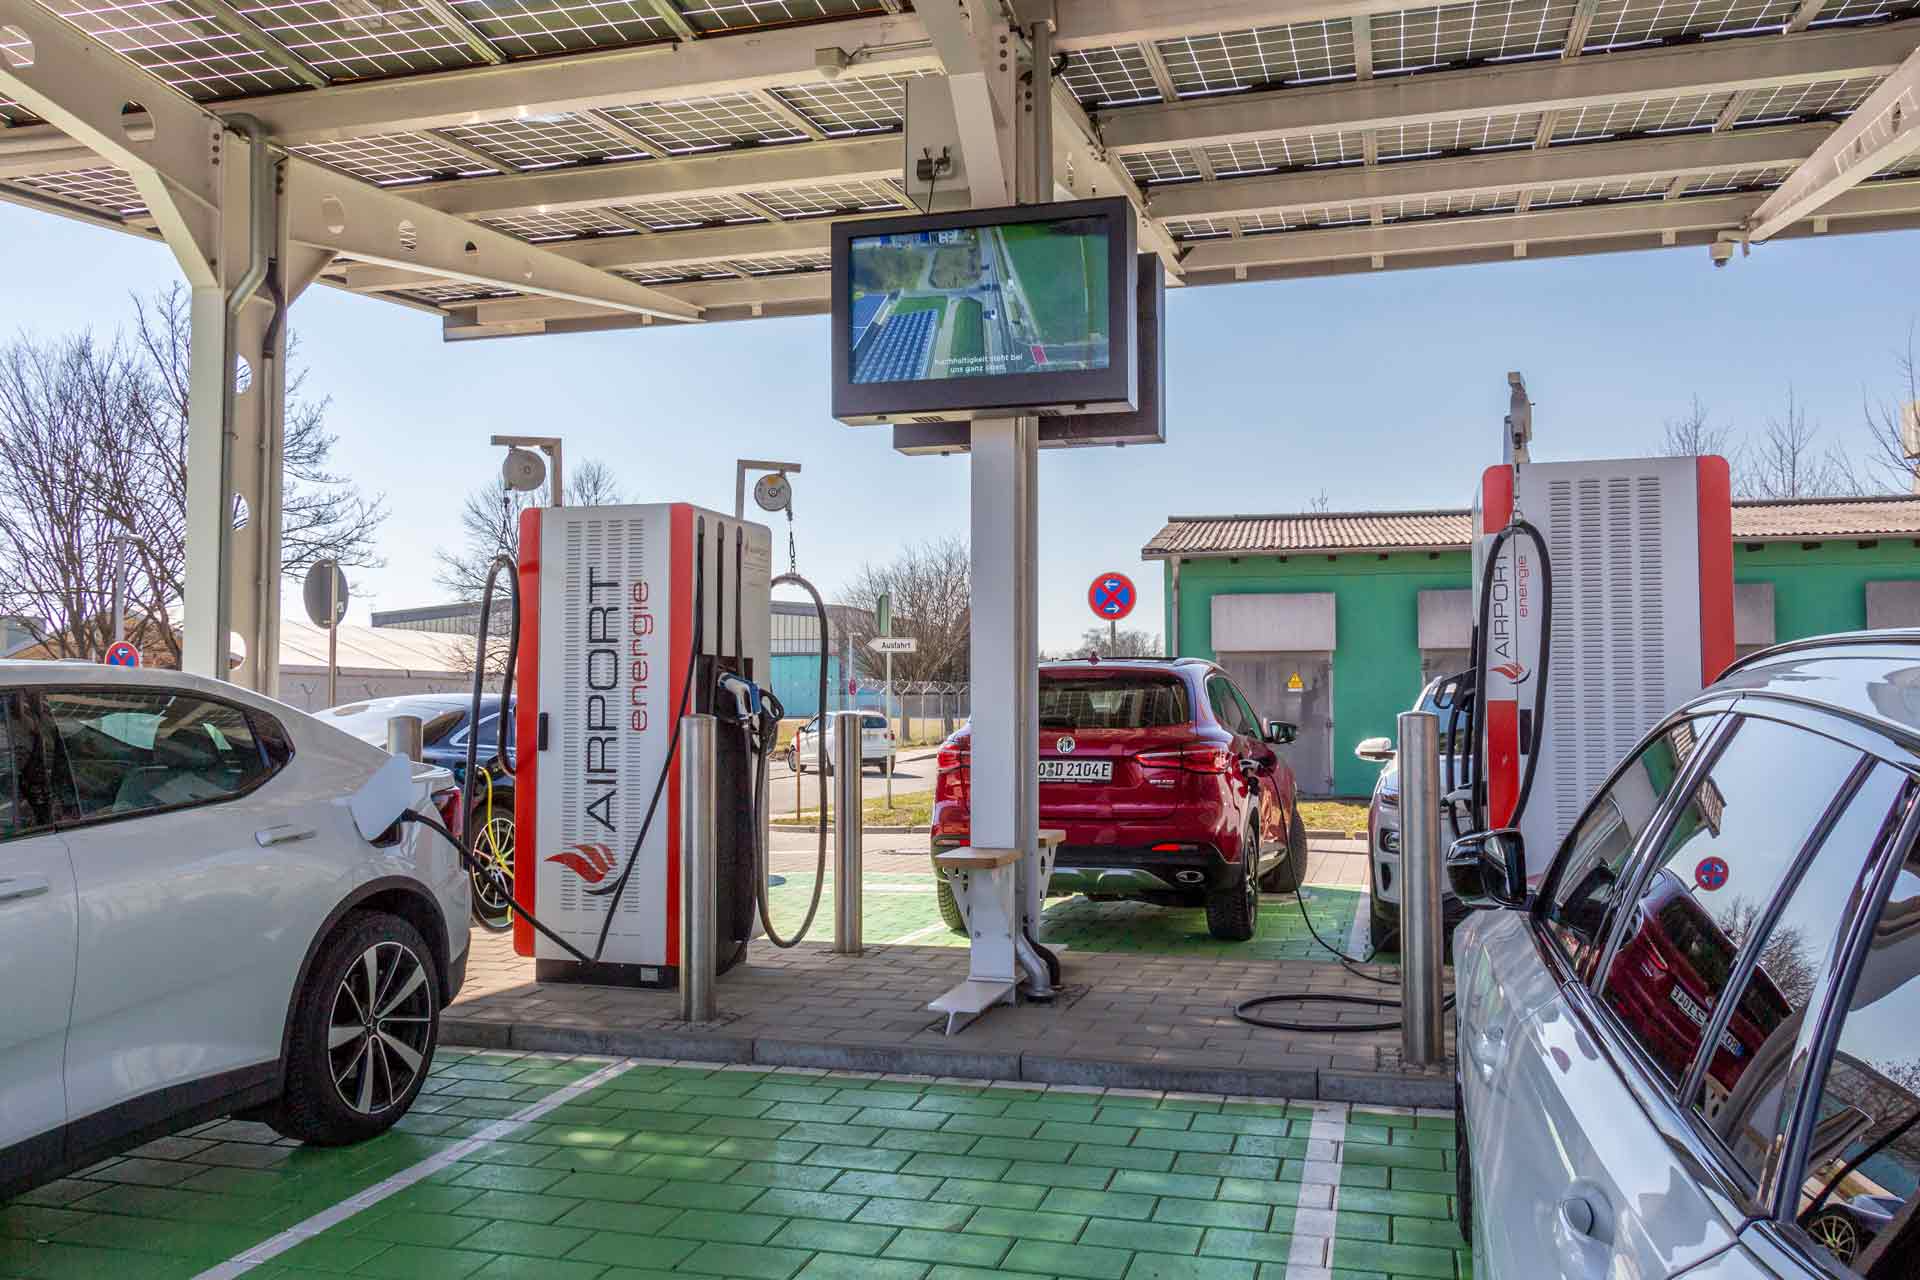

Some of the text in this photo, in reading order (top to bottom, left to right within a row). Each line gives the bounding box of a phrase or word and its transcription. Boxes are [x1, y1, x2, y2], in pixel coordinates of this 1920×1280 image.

[1519, 555, 1530, 618] energie
[627, 581, 654, 732] energie
[881, 641, 911, 649] Ausfahrt
[586, 566, 619, 833] AIRPORT
[1066, 762, 1111, 778] 2104E
